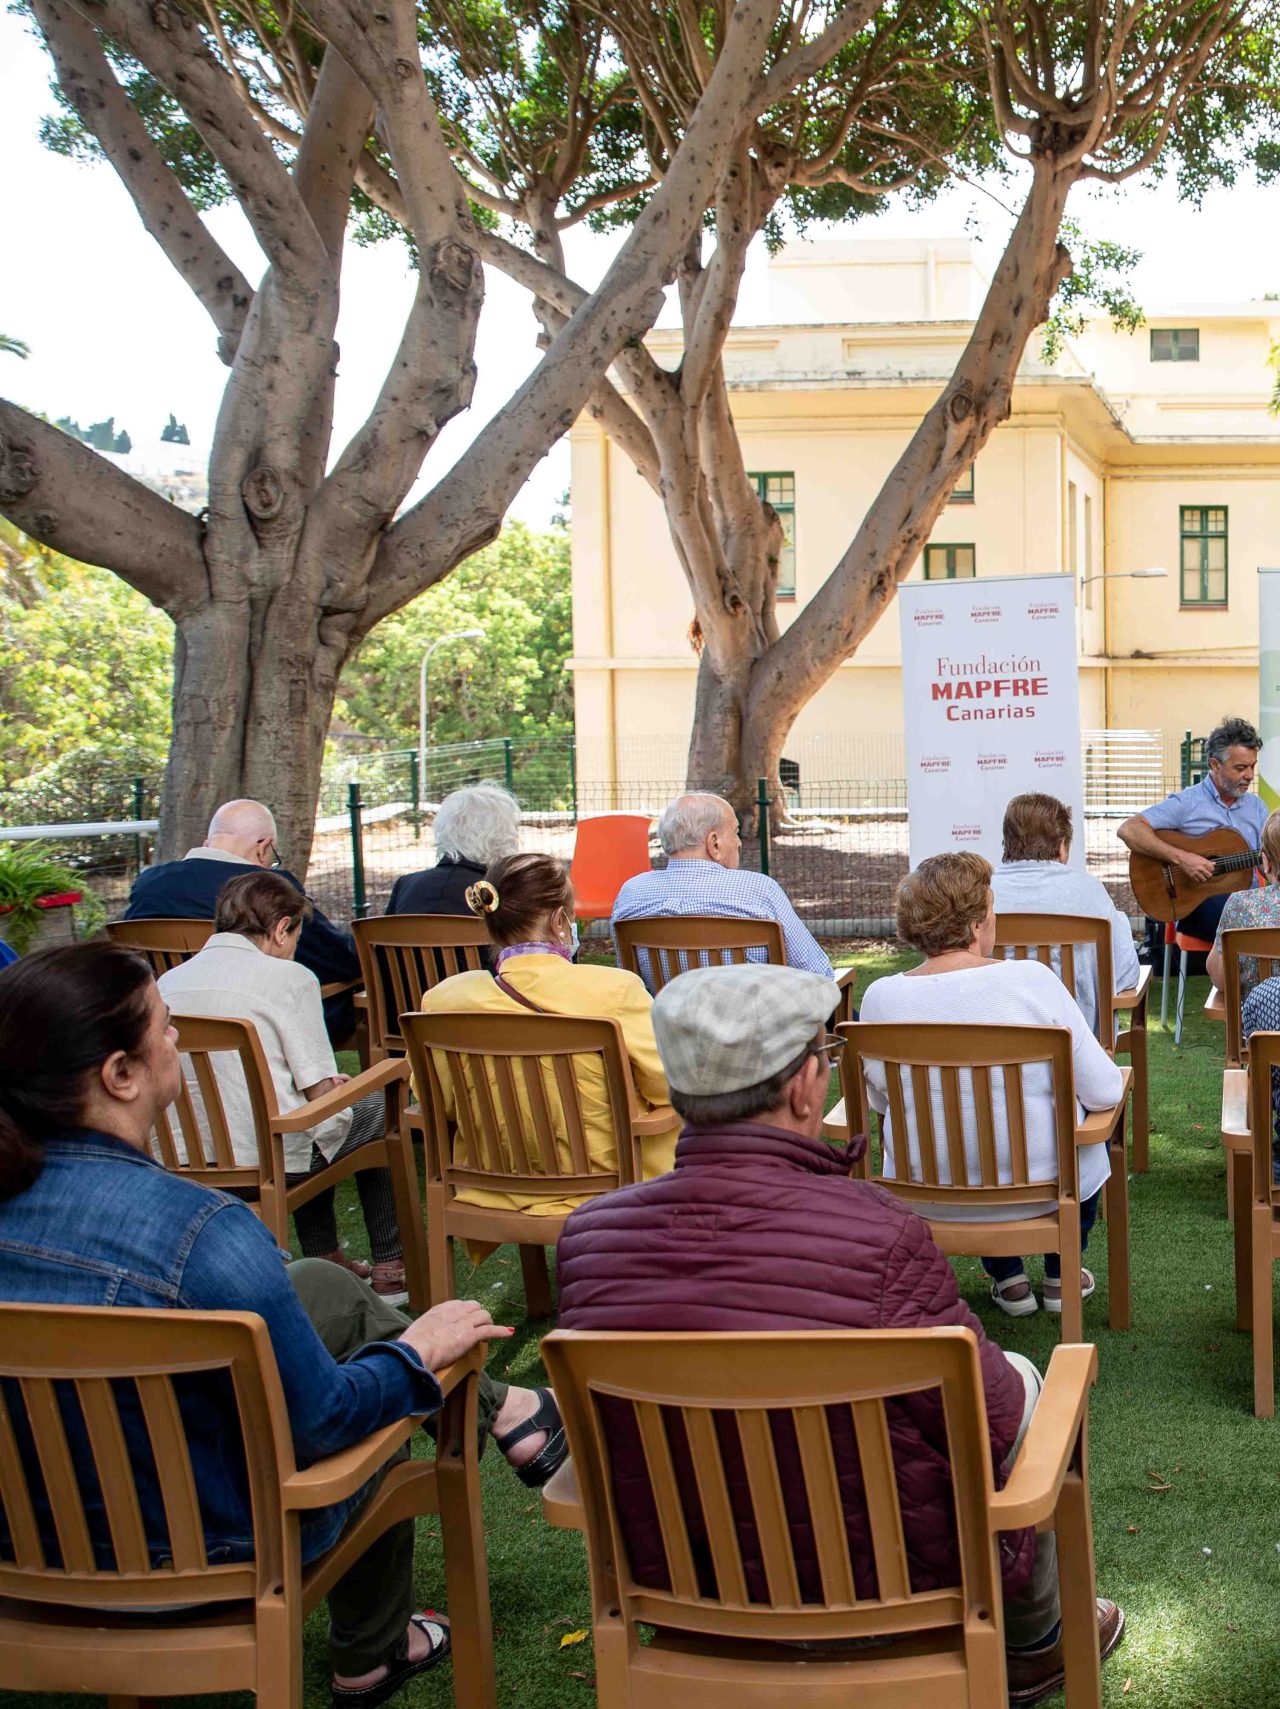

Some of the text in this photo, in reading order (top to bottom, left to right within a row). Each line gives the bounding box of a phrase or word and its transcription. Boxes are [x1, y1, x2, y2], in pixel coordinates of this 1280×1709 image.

[936, 654, 1041, 677] Fundación
[931, 678, 1049, 701] MAPFRE
[946, 704, 1036, 721] Canarias
